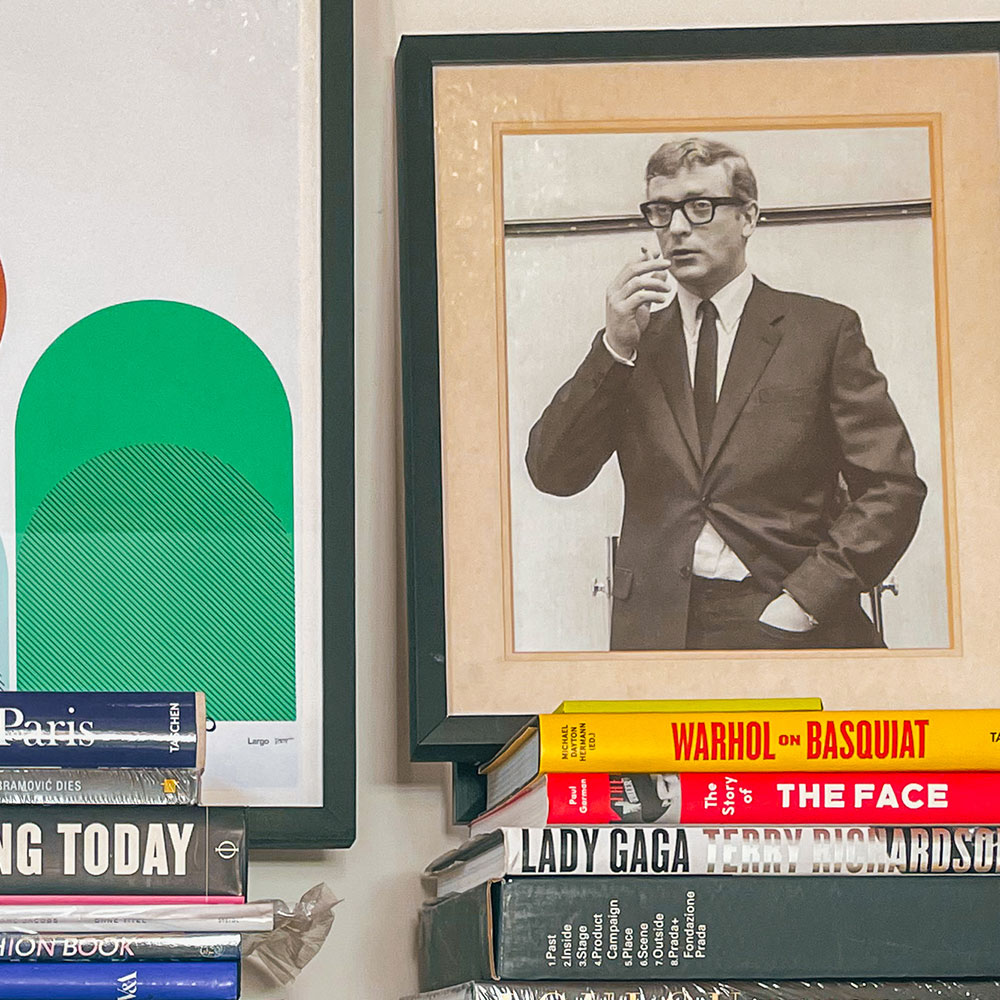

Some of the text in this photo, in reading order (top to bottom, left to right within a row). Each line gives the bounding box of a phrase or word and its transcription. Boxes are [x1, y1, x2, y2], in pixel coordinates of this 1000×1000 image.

[247, 737, 270, 746] Largo
[671, 719, 930, 761] WARHOL BASQUIAT
[56, 780, 82, 791] DIES
[568, 785, 577, 805] Paul
[579, 778, 588, 814] Gorman
[704, 782, 718, 809] The
[721, 776, 738, 816] Story
[776, 783, 949, 809] THE FACE
[57, 823, 195, 875] TODAY
[521, 828, 804, 873] LADY GAGA TERRY
[607, 898, 620, 960] Campaign
[684, 890, 695, 959] Fondazione
[696, 923, 706, 959] Prada
[62, 937, 135, 957] BOOK
